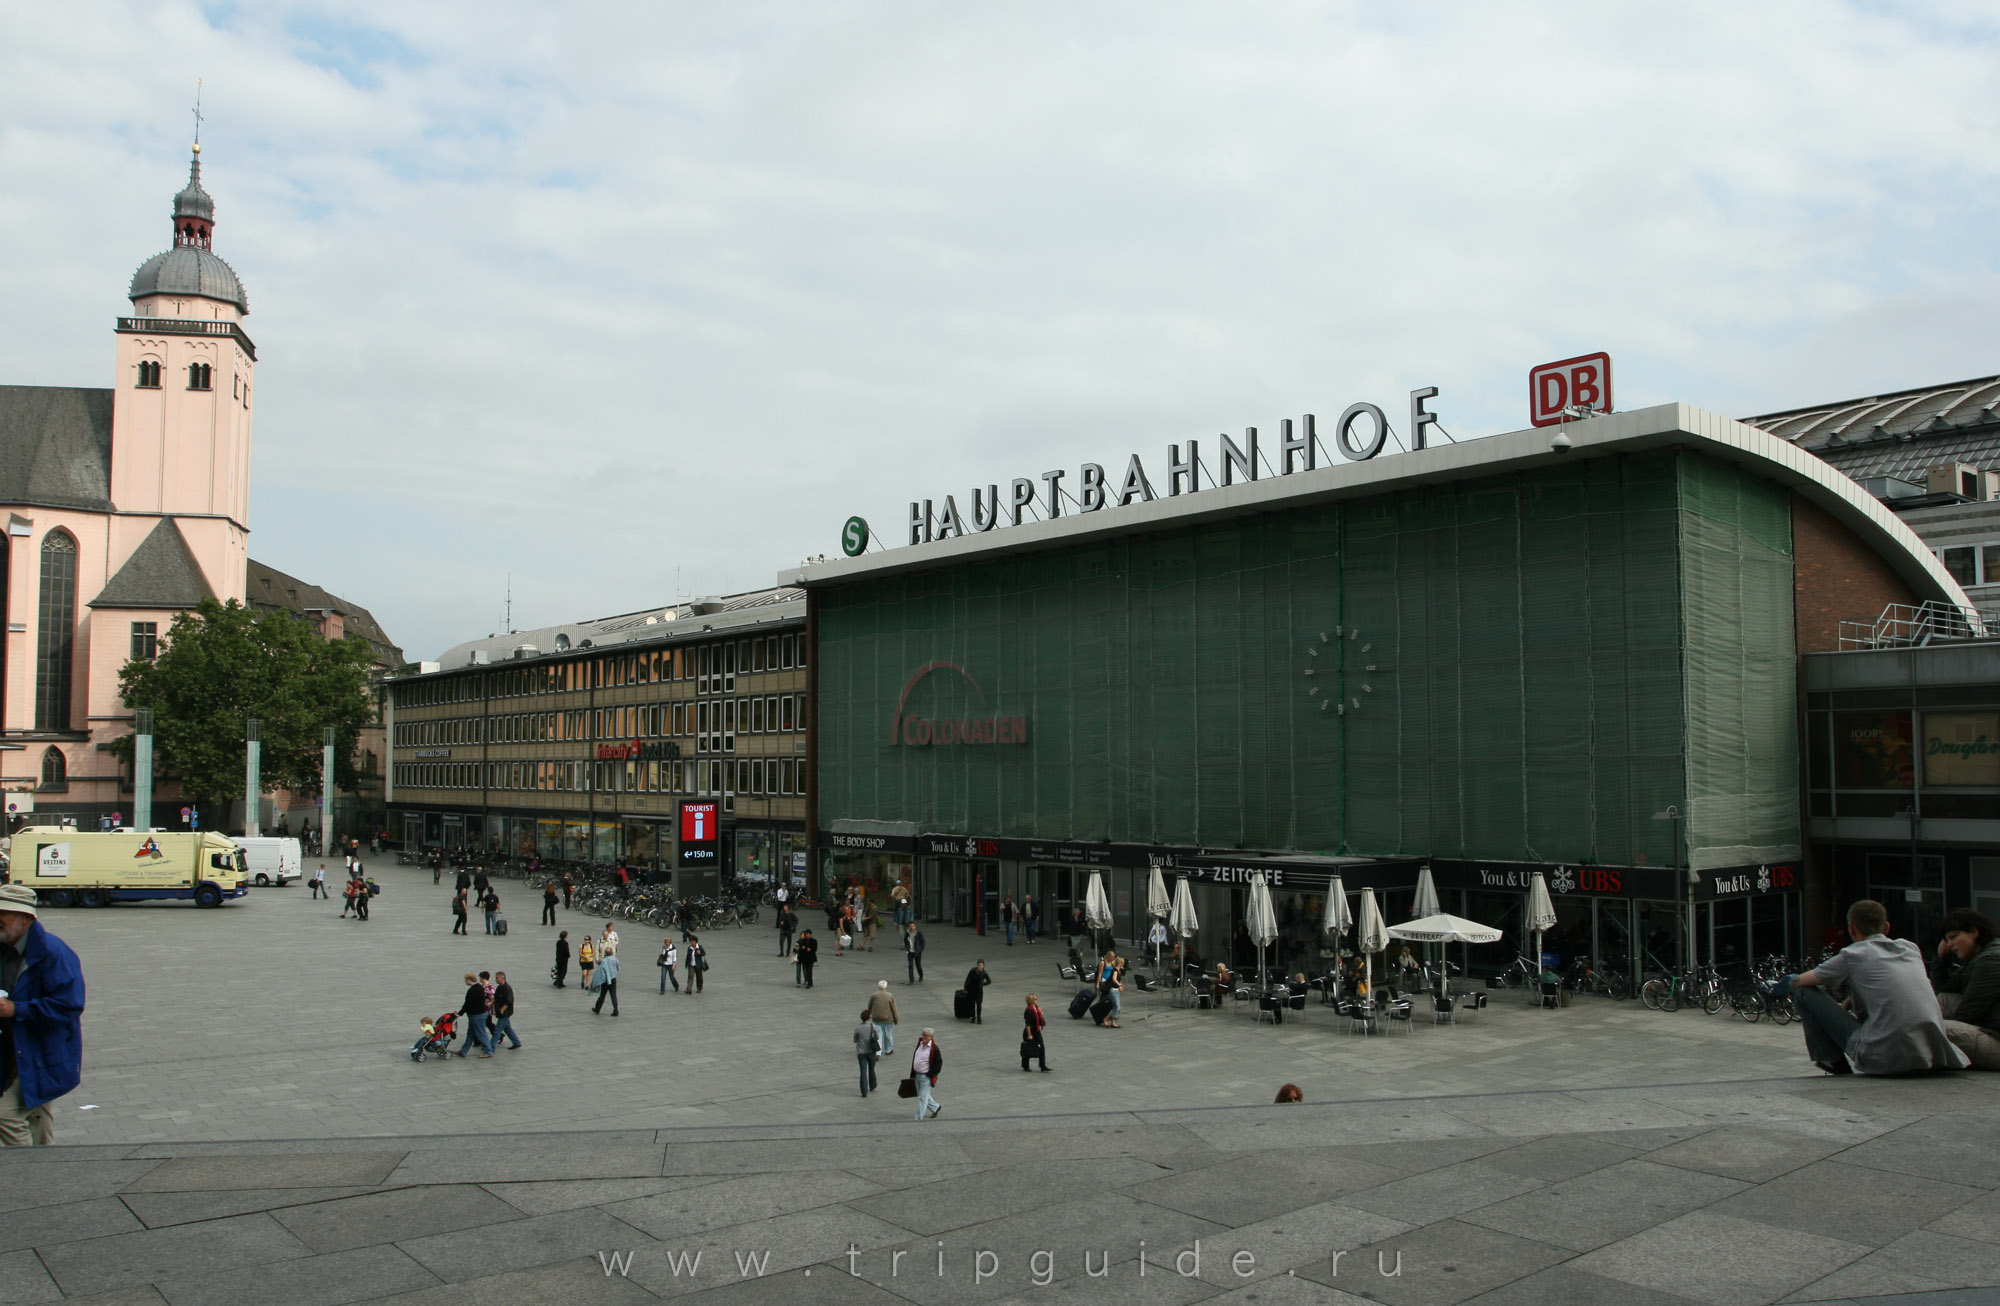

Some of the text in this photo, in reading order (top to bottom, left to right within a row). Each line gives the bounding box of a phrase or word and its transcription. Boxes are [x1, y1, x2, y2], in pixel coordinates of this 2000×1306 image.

[1539, 365, 1599, 416] DB
[909, 386, 1438, 546] HAUPTBAHNHOF
[833, 836, 885, 849] THE BODY SHOP
[931, 840, 959, 853] You & Us
[978, 840, 999, 856] UBS
[693, 850, 705, 858] 150
[1148, 853, 1164, 866] You
[1213, 866, 1283, 886] ZEITCFE
[1480, 869, 1532, 888] You & U
[1579, 869, 1622, 892] UBS
[1715, 875, 1750, 894] You & Us
[1772, 866, 1794, 888] UBS
